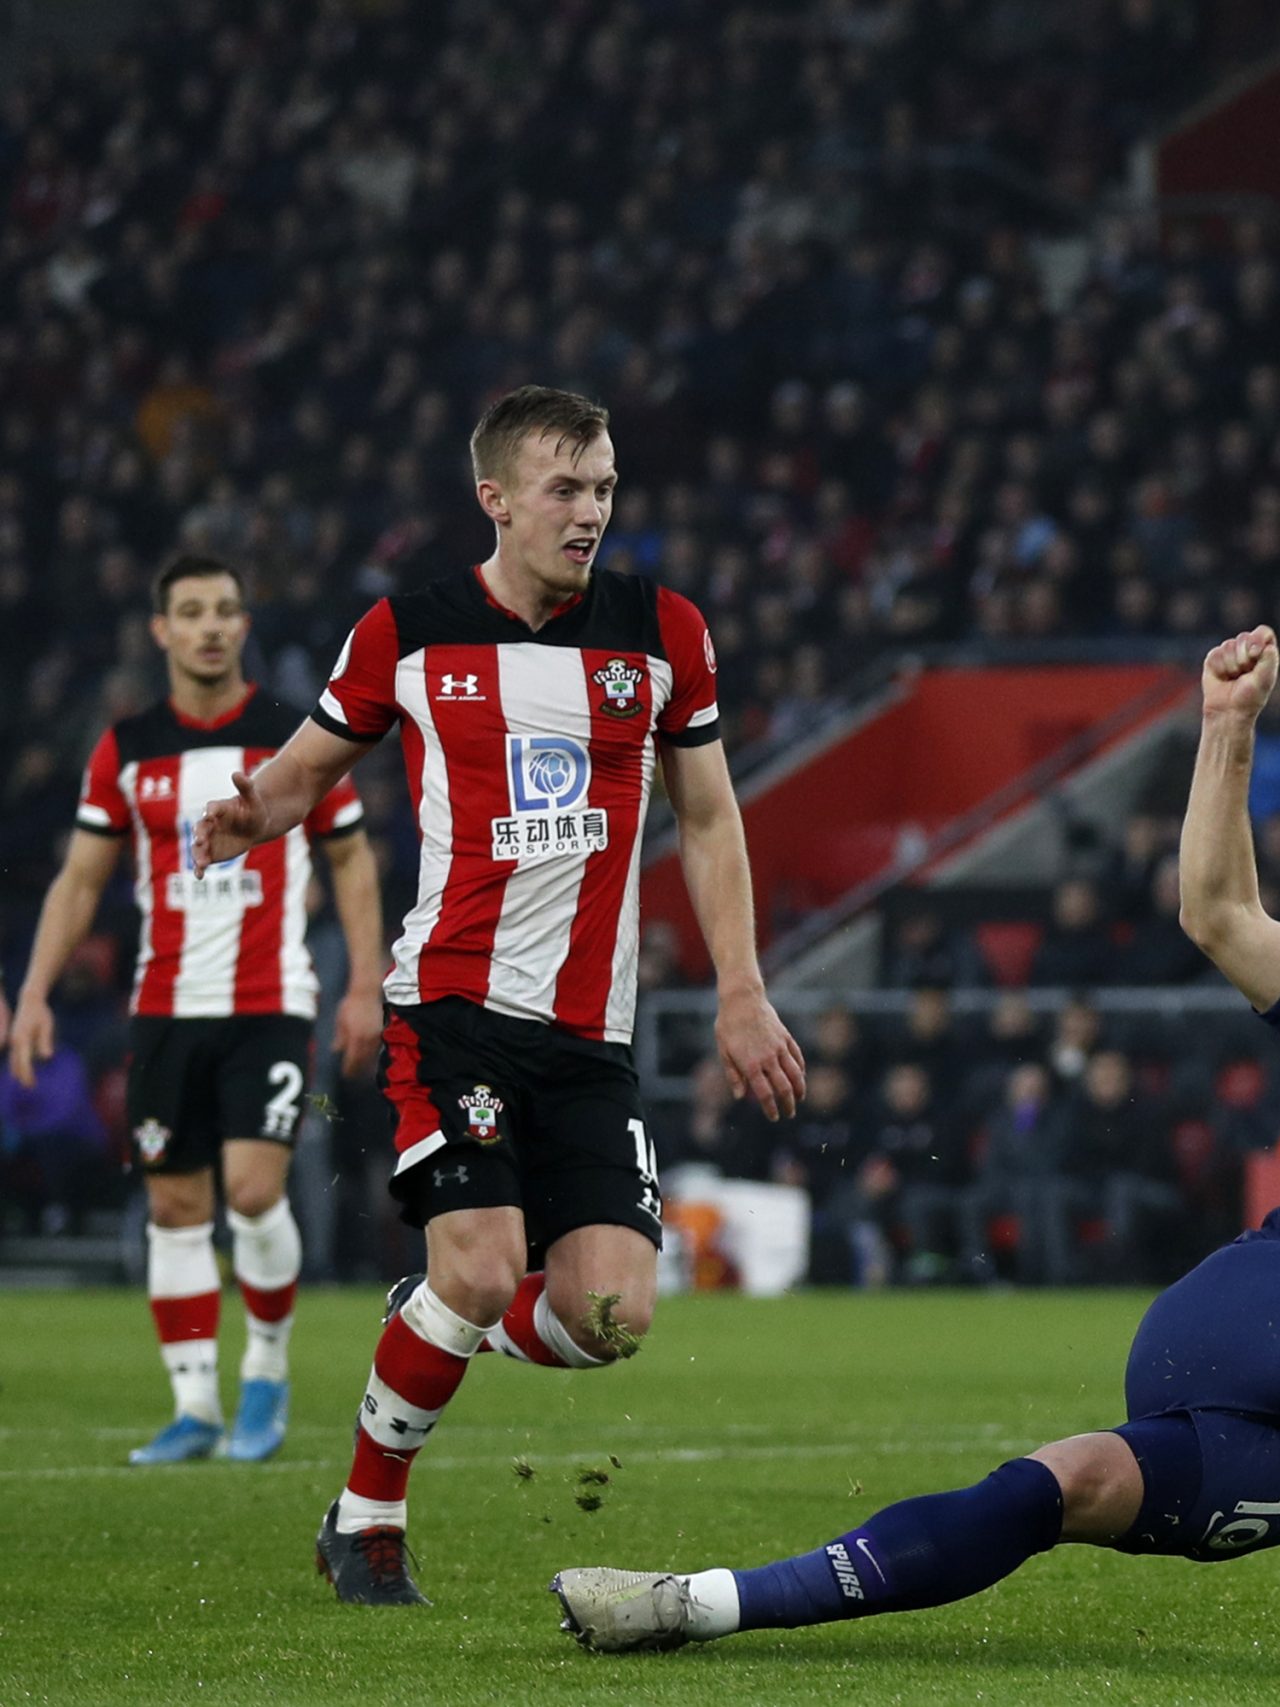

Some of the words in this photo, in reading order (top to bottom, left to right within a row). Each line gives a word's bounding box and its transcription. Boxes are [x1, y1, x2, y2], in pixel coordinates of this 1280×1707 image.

[510, 737, 588, 811] LD
[495, 812, 604, 845] 乐动体育
[496, 838, 605, 856] LDSPORTS
[267, 1060, 303, 1111] 2
[826, 1543, 865, 1600] SPURS
